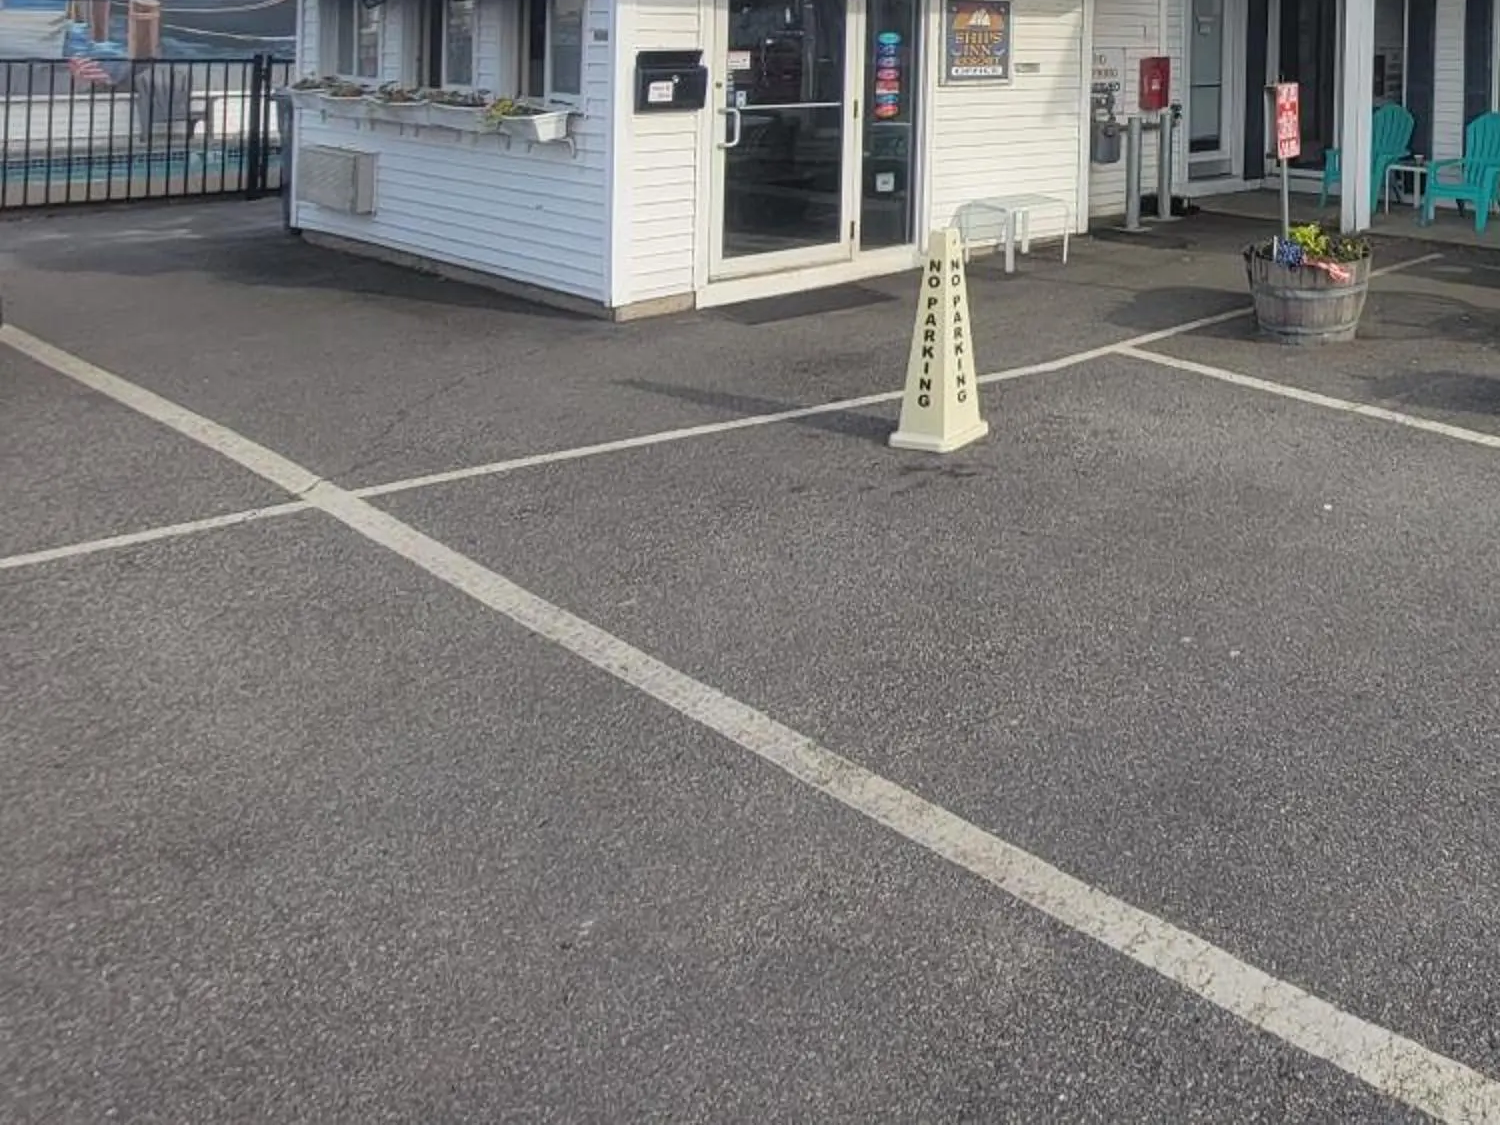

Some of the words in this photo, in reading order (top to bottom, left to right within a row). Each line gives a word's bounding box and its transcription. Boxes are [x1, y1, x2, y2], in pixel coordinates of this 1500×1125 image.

[963, 44, 990, 55] INN
[928, 259, 941, 288] NO
[951, 259, 960, 286] NO
[918, 297, 938, 408] PARKING
[953, 296, 967, 404] PARKING
